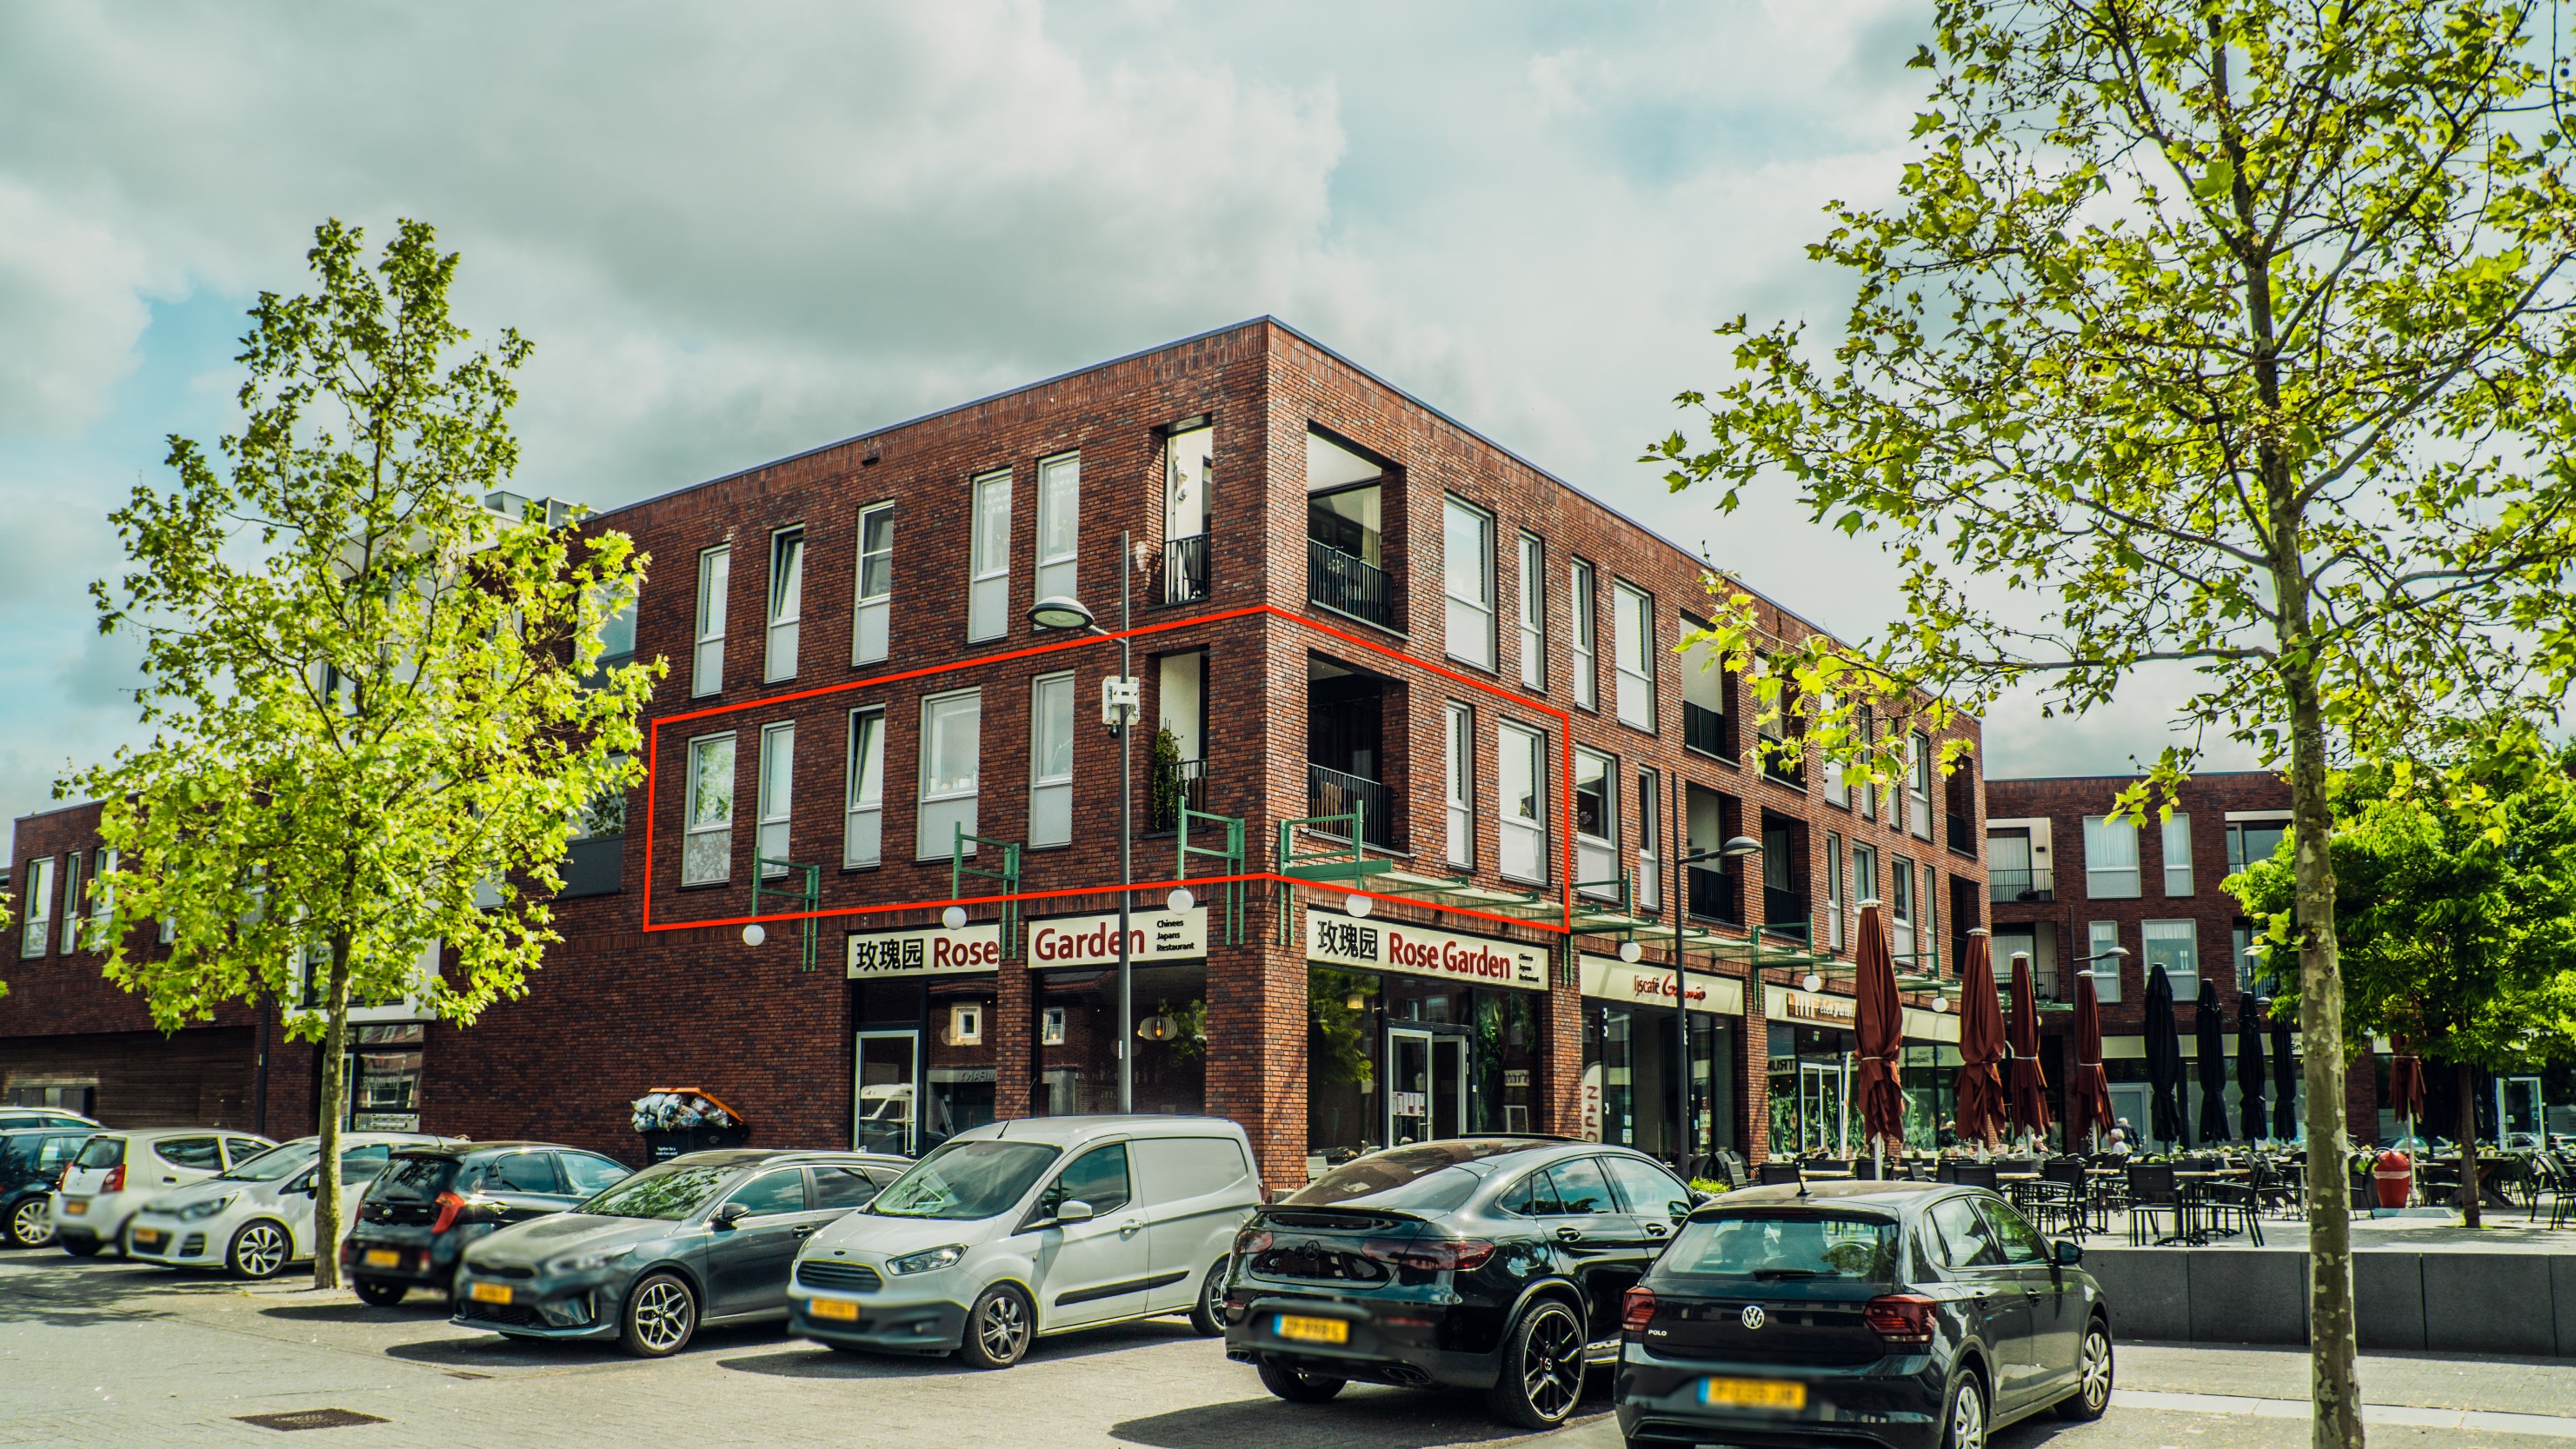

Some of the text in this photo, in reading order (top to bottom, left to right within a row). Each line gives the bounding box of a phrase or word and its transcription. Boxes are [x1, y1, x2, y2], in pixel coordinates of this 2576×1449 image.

[1156, 920, 1184, 928] Chinees
[1156, 932, 1181, 941] Japans
[1317, 920, 1378, 961] 玫瑰园
[855, 937, 924, 972] 玫瑰园
[934, 937, 999, 968] Rose
[1035, 921, 1145, 961] Garden
[1156, 942, 1195, 952] Restaurant
[1389, 932, 1511, 980] Rose Garden
